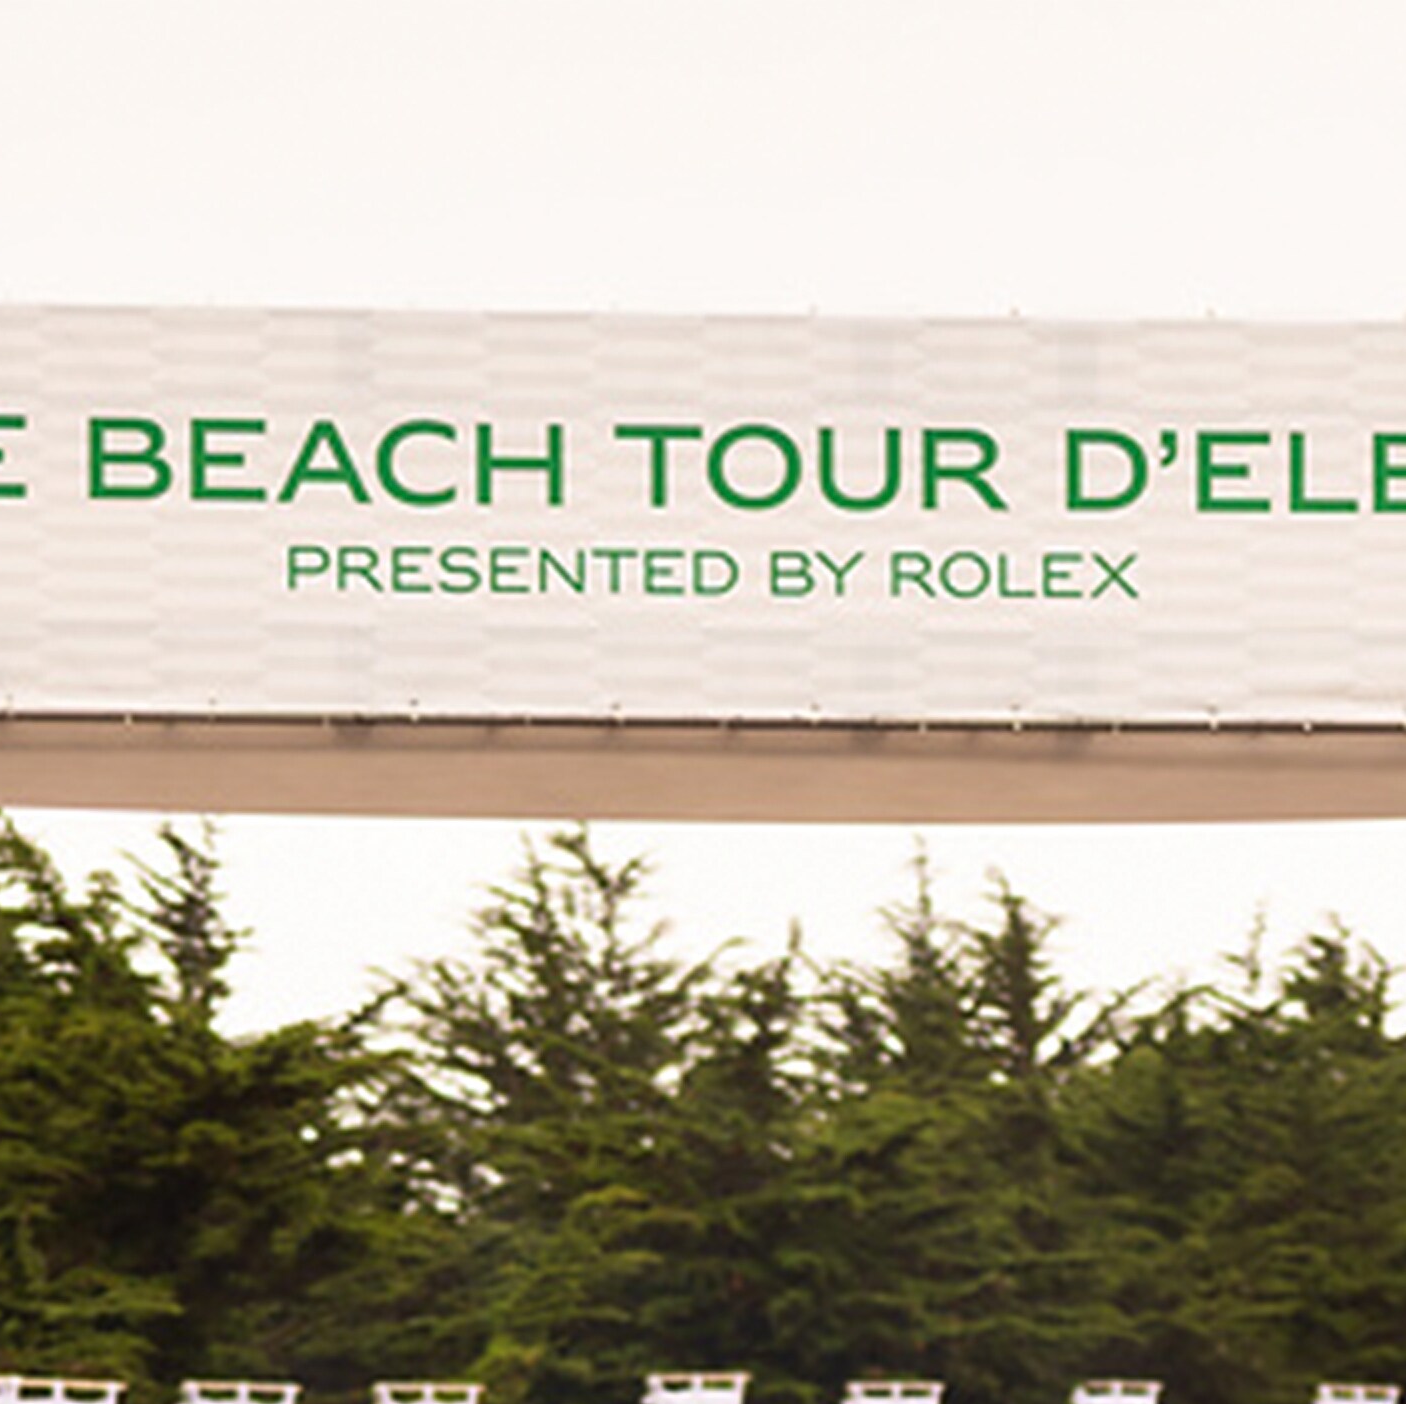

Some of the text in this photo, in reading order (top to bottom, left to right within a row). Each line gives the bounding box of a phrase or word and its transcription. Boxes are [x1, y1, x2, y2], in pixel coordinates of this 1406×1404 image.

[88, 416, 564, 509] BEACH
[613, 424, 1008, 513] TOUR
[287, 546, 1139, 599] PRESENTED BY ROLEX
